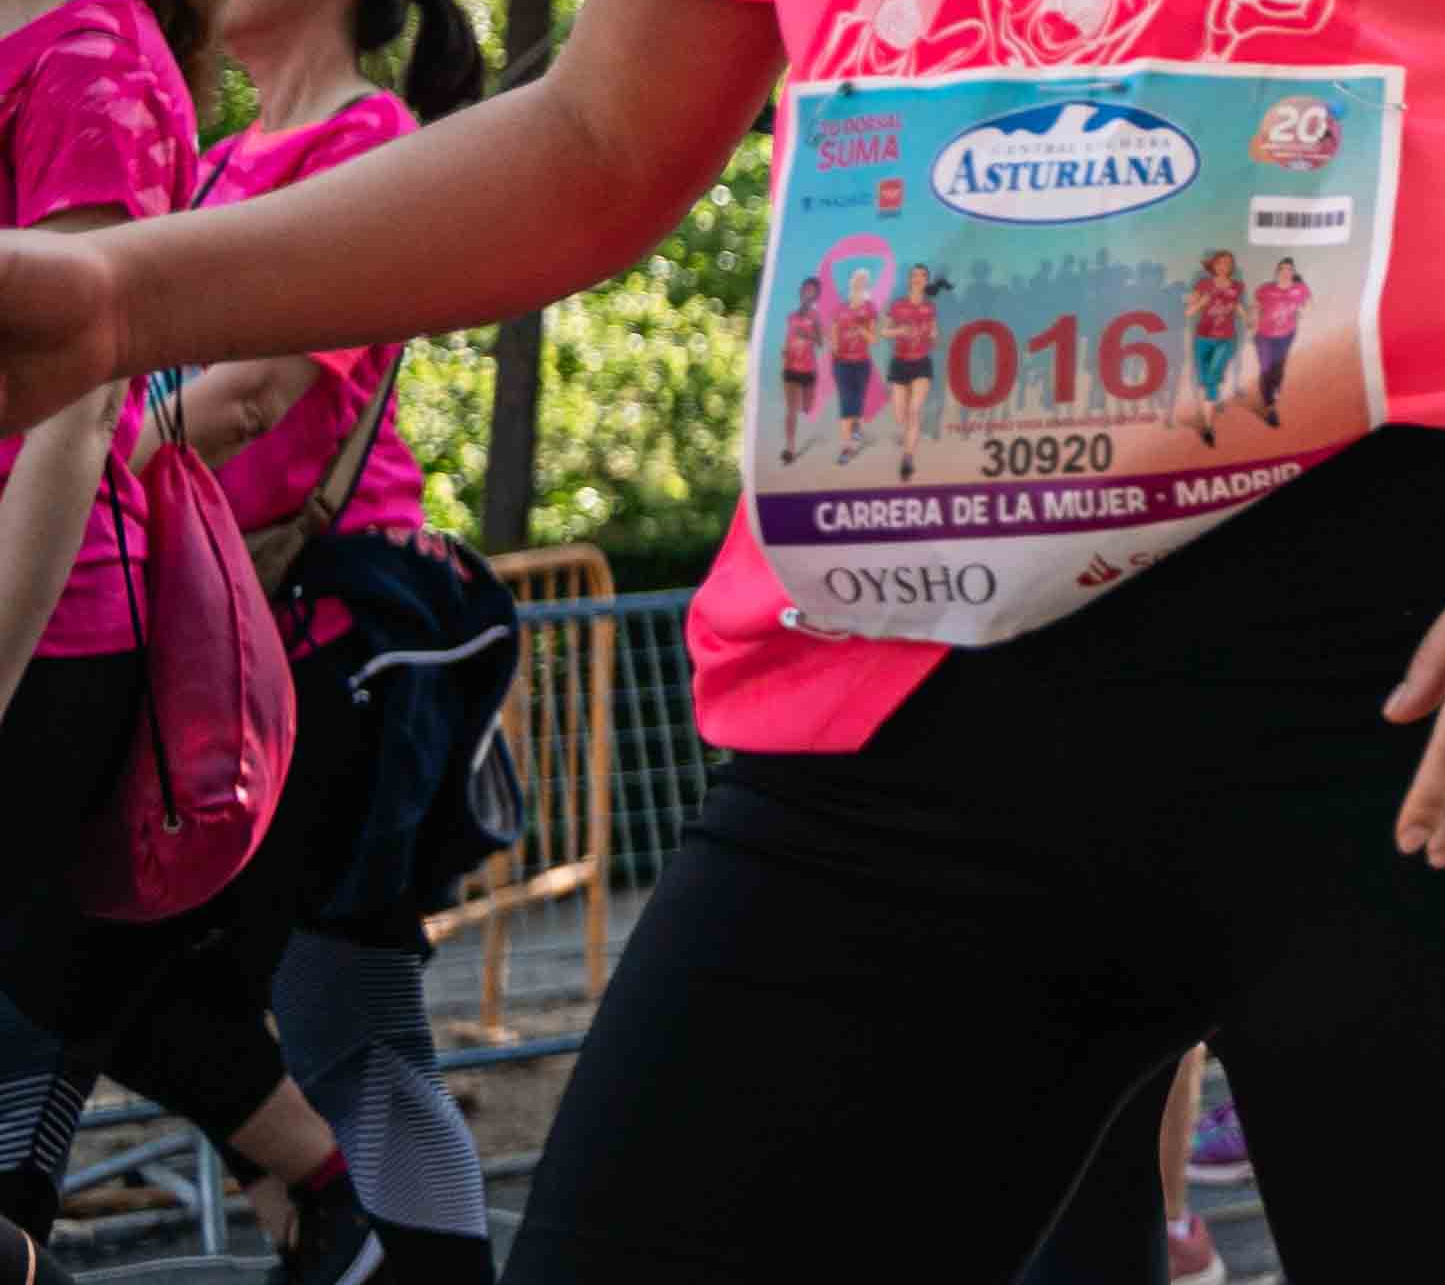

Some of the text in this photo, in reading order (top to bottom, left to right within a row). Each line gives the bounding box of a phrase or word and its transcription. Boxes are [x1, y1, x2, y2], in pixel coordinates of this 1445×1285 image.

[1268, 104, 1329, 144] 20
[816, 134, 900, 172] SUMA
[947, 147, 1177, 196] ASTURIANA
[946, 310, 1169, 409] 016
[979, 432, 1114, 478] 30920
[815, 498, 944, 533] CARRERA
[952, 494, 989, 524] DE
[996, 491, 1035, 522] LA
[1043, 484, 1148, 519] MUJER
[824, 563, 998, 606] OYSHO
